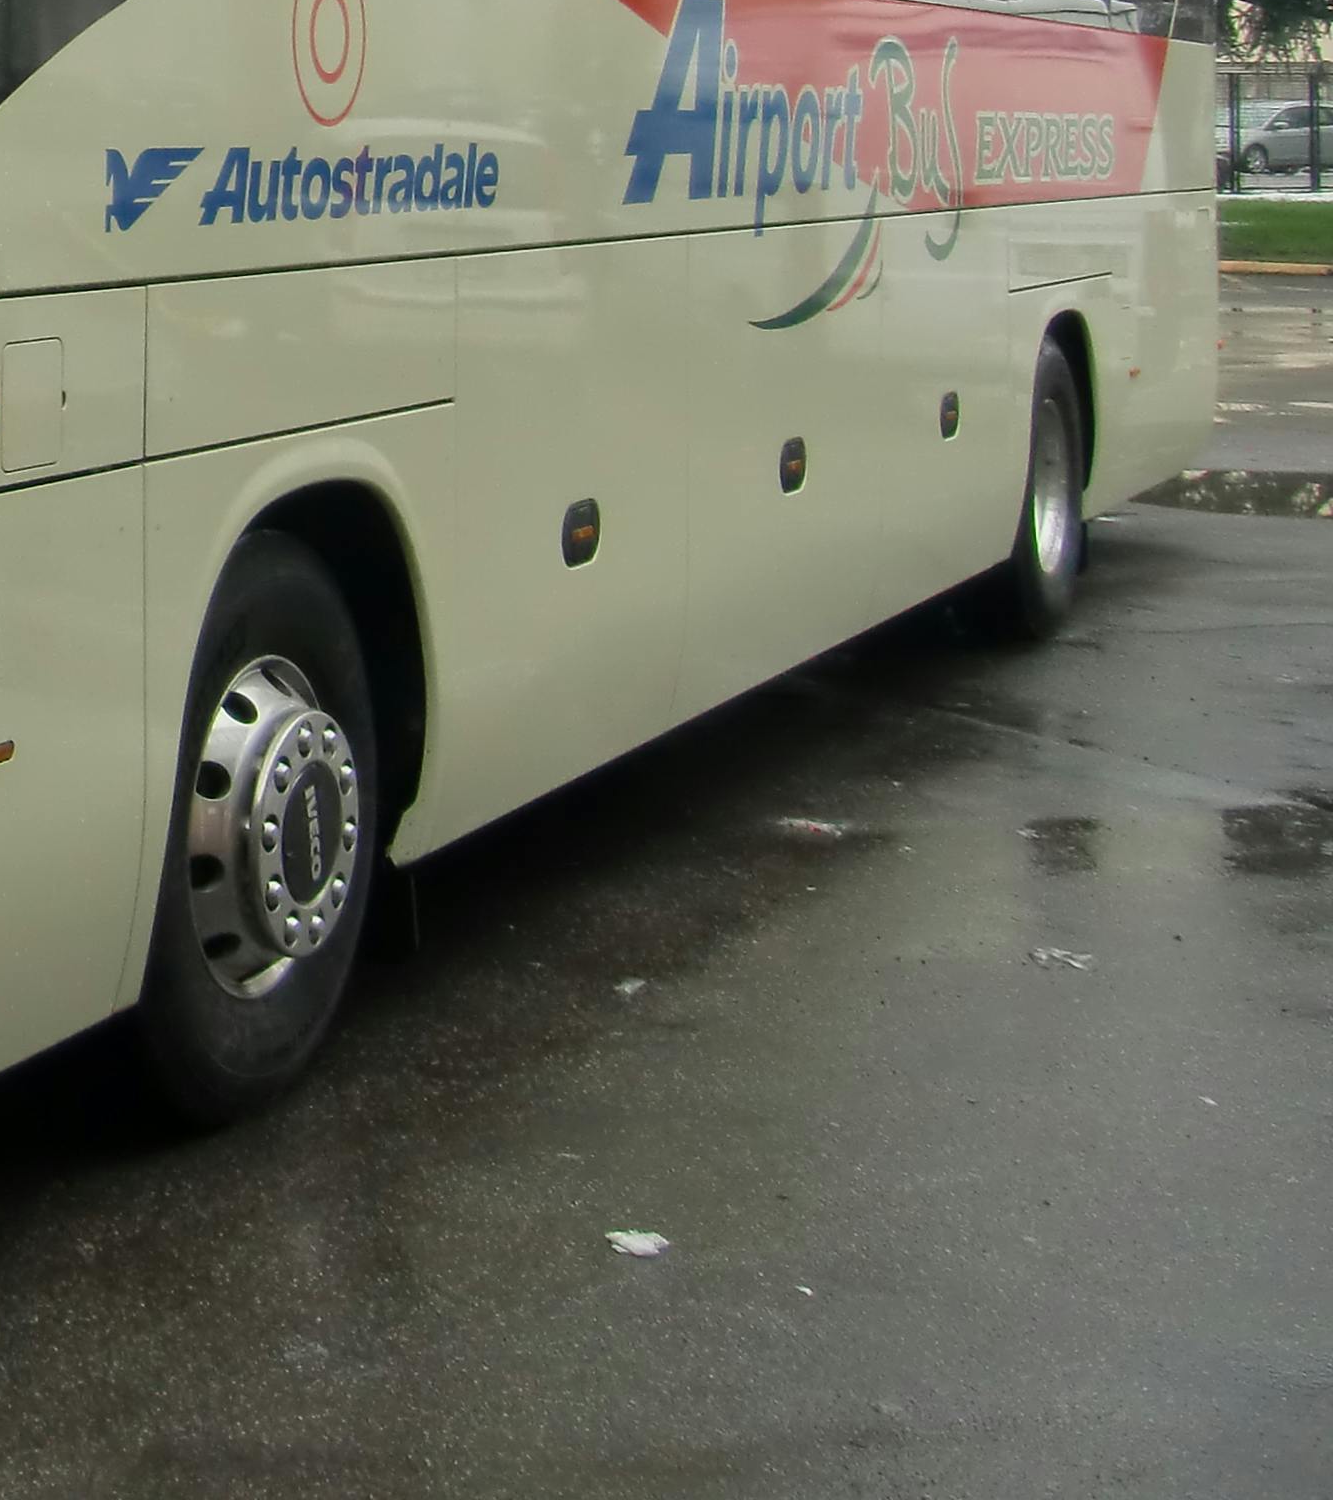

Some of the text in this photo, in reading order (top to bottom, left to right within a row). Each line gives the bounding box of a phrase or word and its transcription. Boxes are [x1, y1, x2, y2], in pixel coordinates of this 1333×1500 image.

[198, 141, 499, 227] Autostradale
[973, 110, 1115, 186] EXPRESS
[303, 784, 322, 882] IVECO
